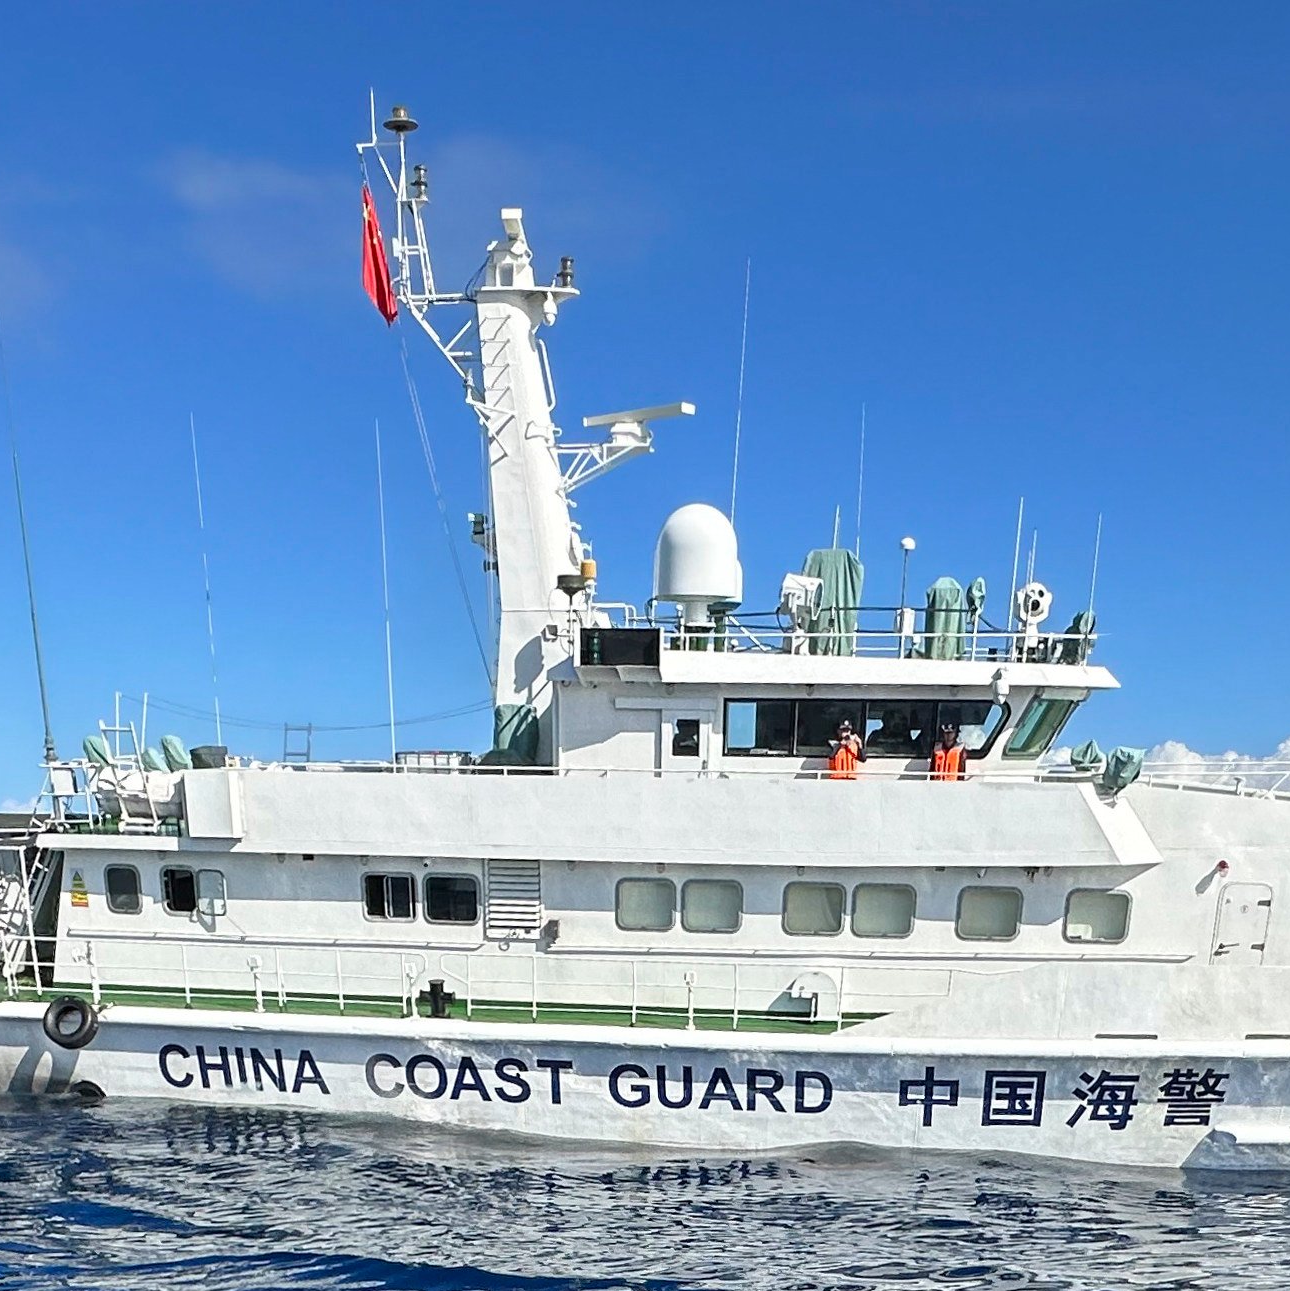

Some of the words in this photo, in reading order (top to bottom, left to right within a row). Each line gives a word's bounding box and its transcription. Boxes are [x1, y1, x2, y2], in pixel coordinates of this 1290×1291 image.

[158, 1043, 331, 1095] CHINA
[364, 1052, 574, 1105] COAST
[607, 1063, 834, 1114] GUARD
[897, 1066, 1231, 1131] 中国海警
